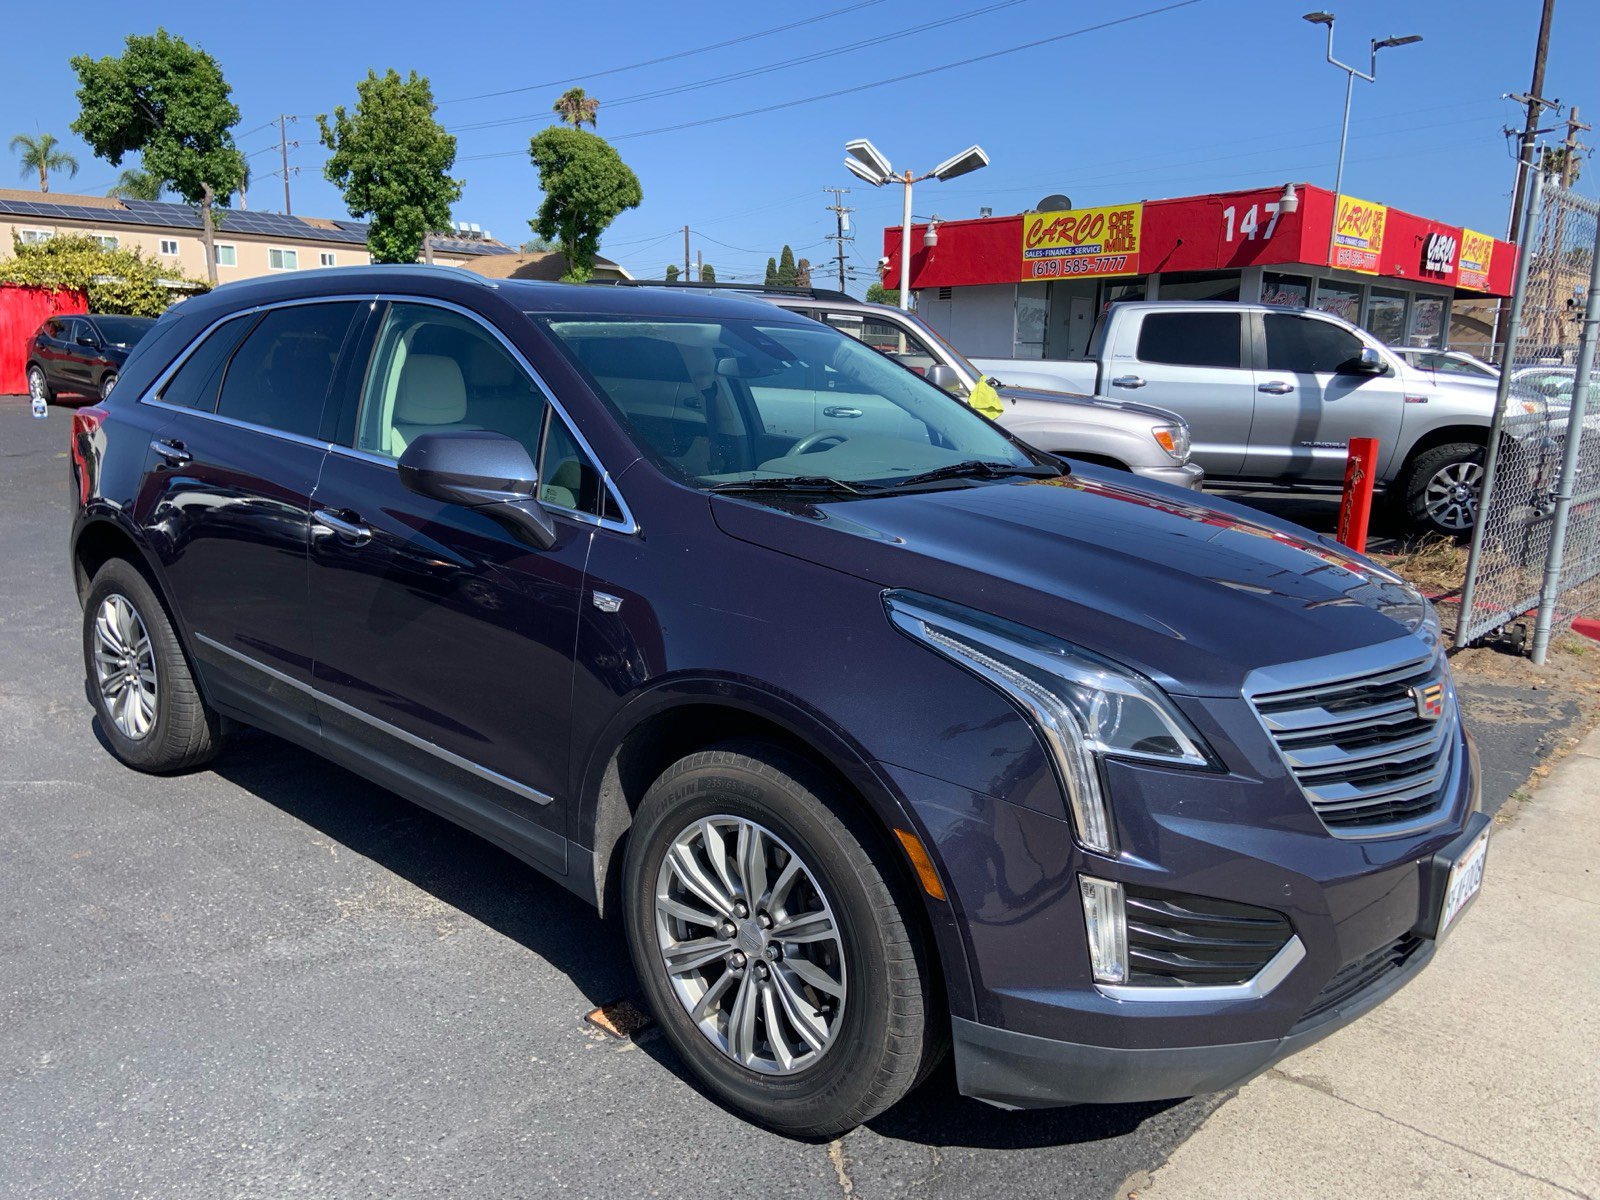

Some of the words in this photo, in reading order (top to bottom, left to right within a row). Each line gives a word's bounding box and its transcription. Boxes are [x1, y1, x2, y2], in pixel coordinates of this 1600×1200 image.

[1108, 210, 1134, 225] OFF
[1222, 202, 1281, 242] 147
[1026, 213, 1105, 248] CARCO
[1108, 223, 1134, 239] THE
[1103, 237, 1136, 253] MILE
[1032, 260, 1061, 278] (619)
[1064, 256, 1127, 273] 585-7777
